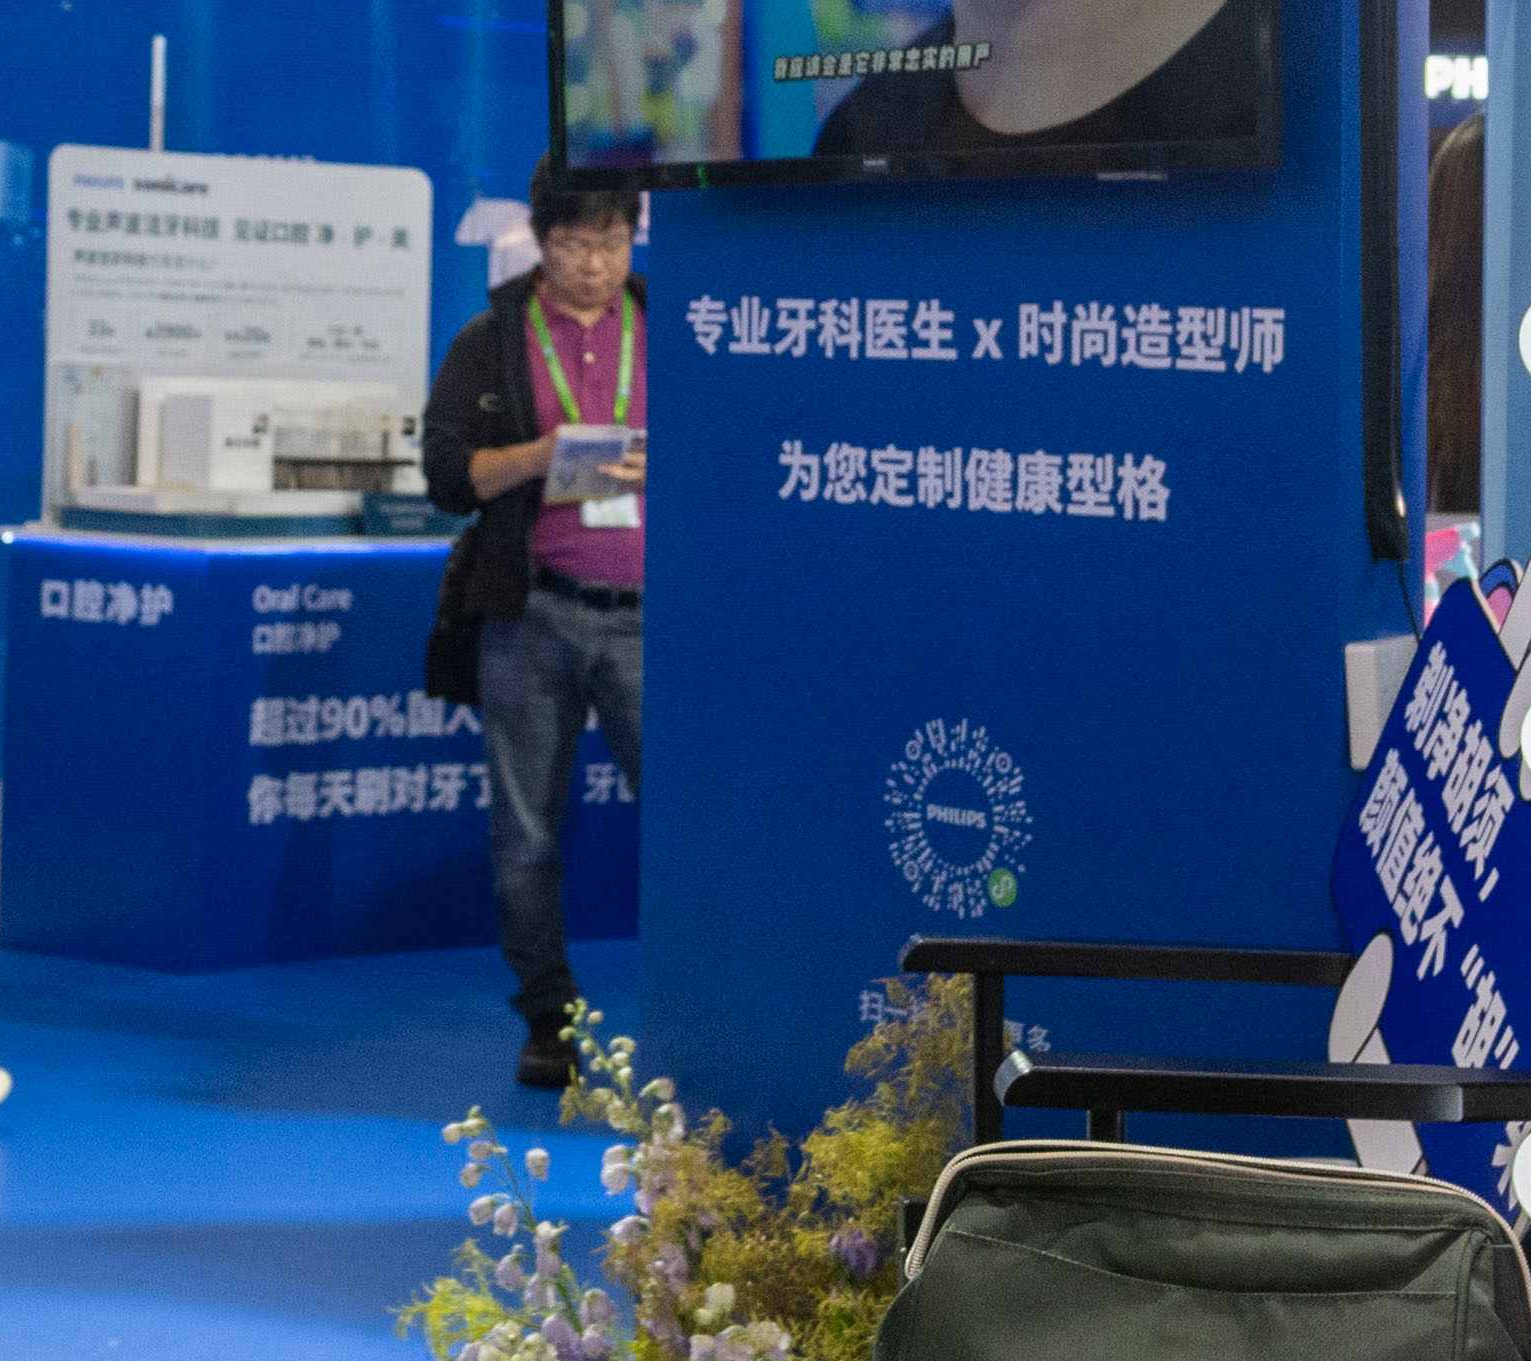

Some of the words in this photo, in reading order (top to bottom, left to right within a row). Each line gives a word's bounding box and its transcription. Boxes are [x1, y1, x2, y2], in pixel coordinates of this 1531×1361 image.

[687, 295, 958, 362] 专业牙科医生
[1018, 301, 1285, 374] 时尚造型师
[778, 440, 1171, 521] 为您定制健康型格
[41, 580, 172, 626] 口腔净护
[252, 584, 300, 613] Oral
